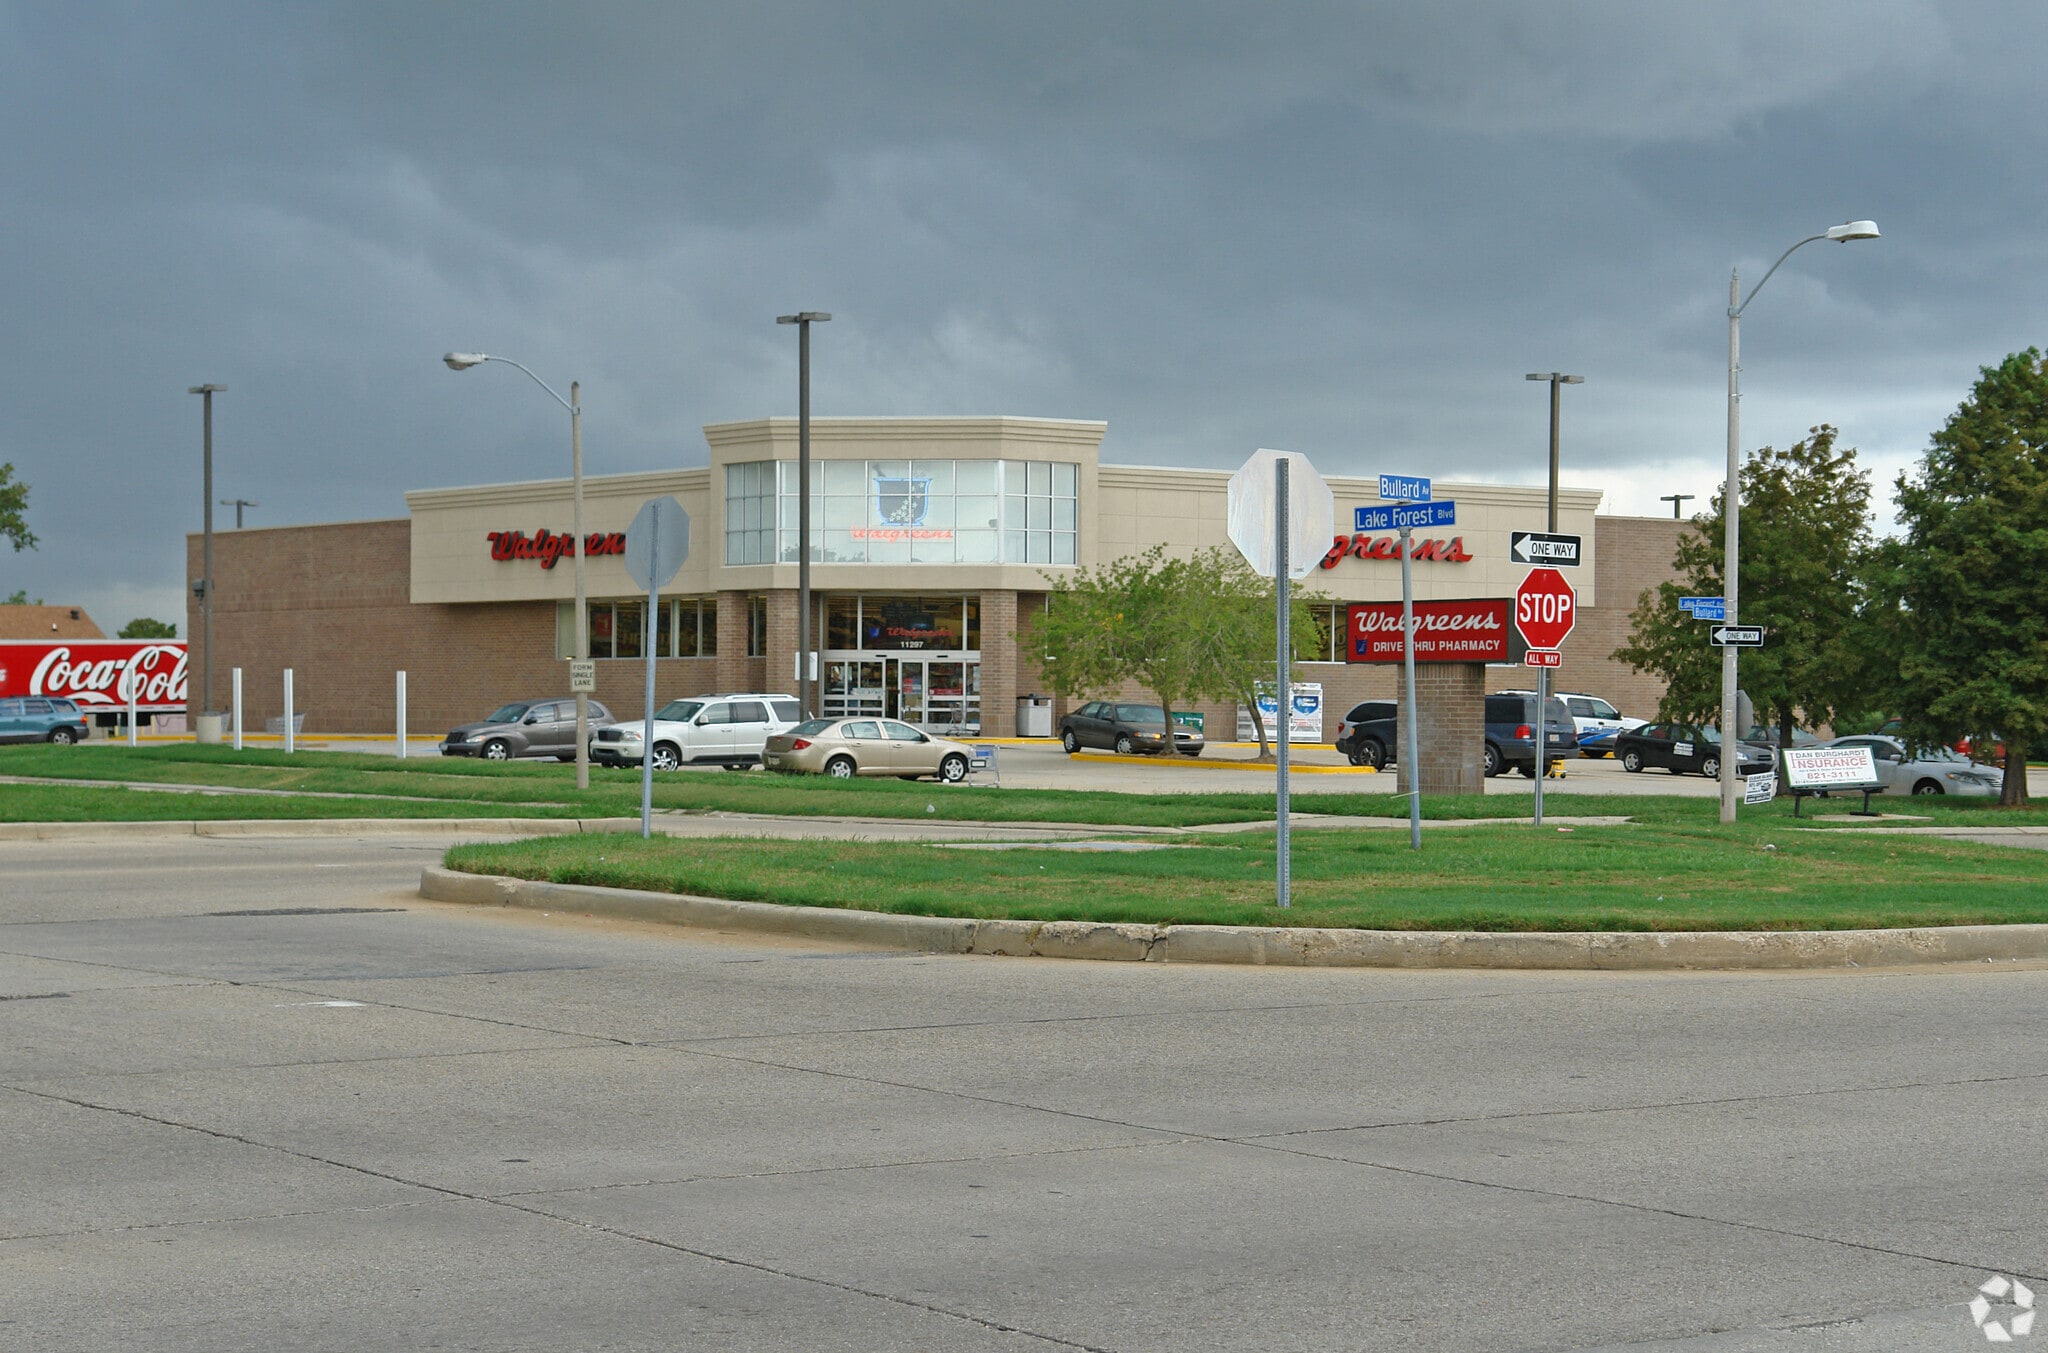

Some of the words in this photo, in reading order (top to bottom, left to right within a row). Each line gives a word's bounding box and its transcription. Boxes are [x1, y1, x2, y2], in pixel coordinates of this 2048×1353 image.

[1381, 477, 1420, 498] Bullard
[1422, 487, 1429, 495] Av
[1356, 510, 1388, 529] Lake
[1392, 507, 1433, 526] Forest
[1438, 508, 1454, 519] Blvd
[486, 528, 626, 569] Walgren
[1321, 533, 1473, 570] greens
[1531, 542, 1550, 555] ONE
[1554, 544, 1574, 557] WAY
[1519, 593, 1571, 623] STOP
[1680, 600, 1694, 608] Lake
[1695, 608, 1717, 617] Bullard
[1355, 610, 1501, 636] Walgreens
[1726, 632, 1740, 640] ONE
[1742, 632, 1757, 640] WAY
[900, 641, 924, 649] 11297
[1373, 641, 1403, 652] DRIVE
[1413, 640, 1436, 652] HRU
[1439, 640, 1501, 651] PHARMACY
[1528, 653, 1541, 664] ALL
[1544, 653, 1559, 664] WAY
[1789, 752, 1868, 769] INSURANCE
[1815, 750, 1866, 758] BURGHARDT
[1807, 771, 1857, 779] 821-3111
